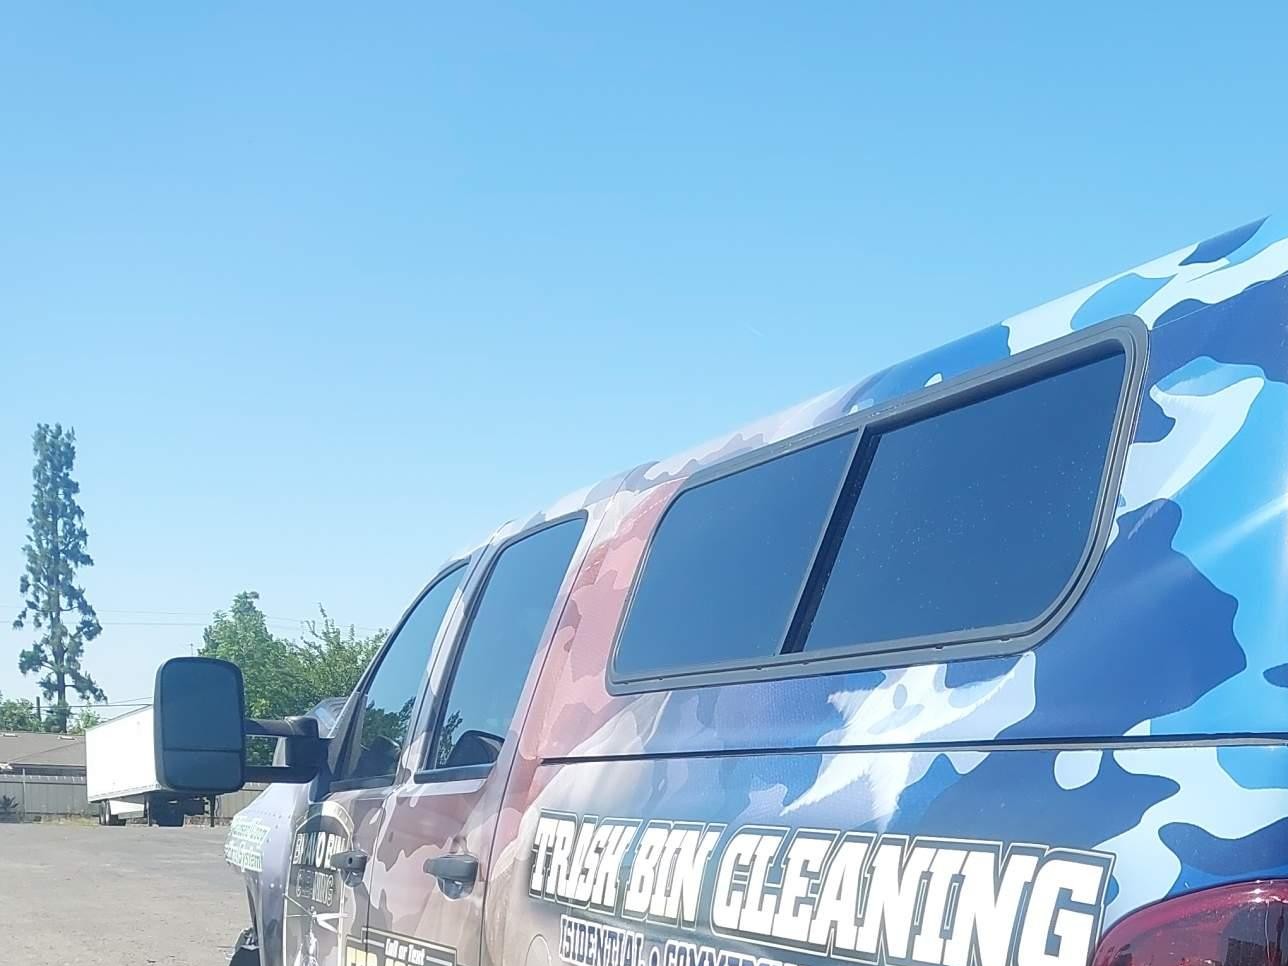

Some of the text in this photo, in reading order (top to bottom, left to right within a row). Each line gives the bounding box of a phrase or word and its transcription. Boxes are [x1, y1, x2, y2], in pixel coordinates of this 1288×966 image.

[531, 817, 637, 906] TRASH
[624, 827, 721, 921] BIN
[408, 944, 426, 966] Text
